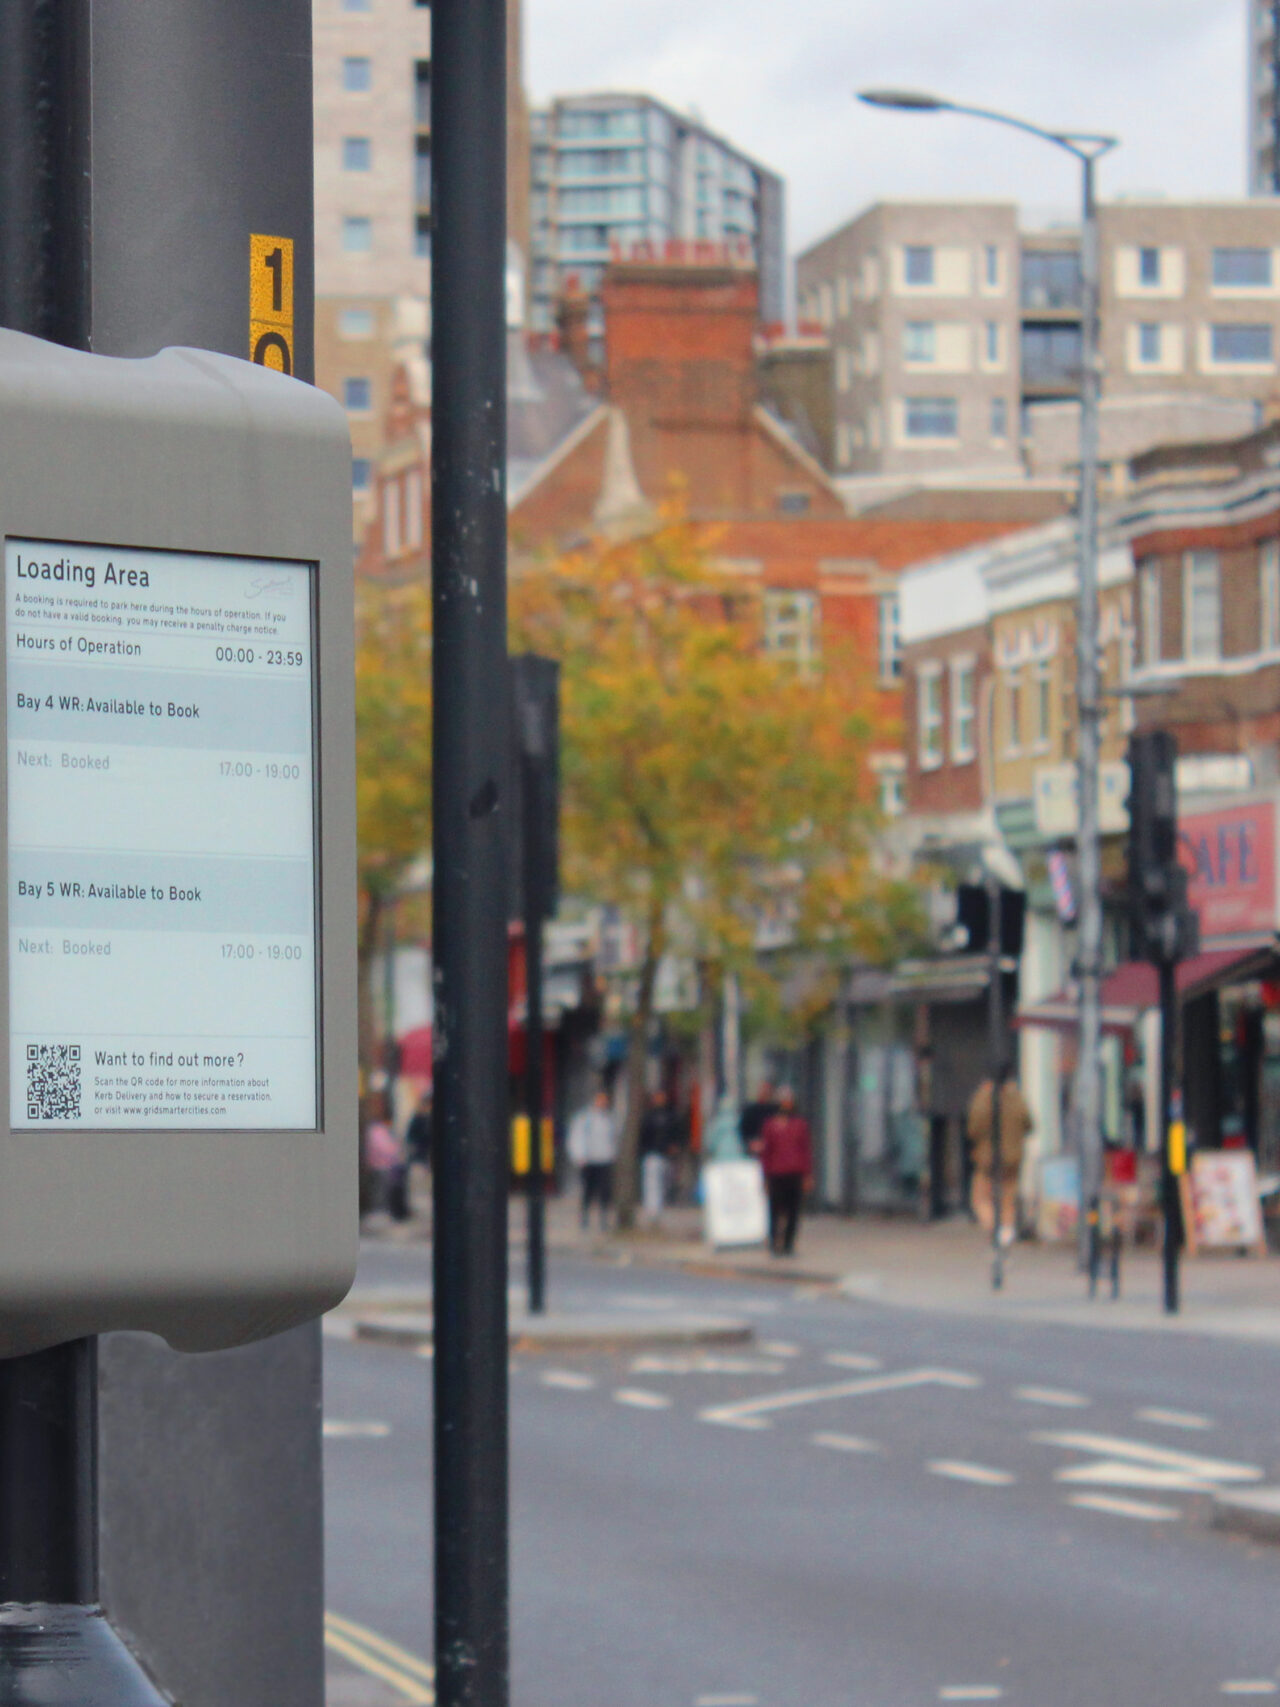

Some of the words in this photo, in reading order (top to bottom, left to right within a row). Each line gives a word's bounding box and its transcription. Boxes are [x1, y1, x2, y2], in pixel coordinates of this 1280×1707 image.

[17, 555, 96, 588] Loading
[104, 562, 150, 588] Area
[15, 593, 21, 602] A
[23, 594, 54, 606] booking
[56, 595, 64, 605] is
[65, 598, 98, 609] required
[100, 599, 109, 609] to
[111, 601, 128, 612] park
[130, 602, 148, 612] here
[149, 604, 174, 616] during
[176, 606, 189, 615] the
[190, 607, 212, 617] hours
[214, 608, 222, 617] of
[264, 611, 271, 620] If
[272, 614, 287, 623] you
[15, 607, 26, 617] do
[27, 609, 41, 618] not
[43, 610, 61, 620] have
[70, 613, 89, 622] valid
[126, 617, 141, 627] you
[142, 618, 158, 628] may
[160, 618, 188, 629] receive
[196, 621, 225, 632] penalty
[226, 622, 252, 635] charge
[16, 633, 55, 650] Hours
[60, 636, 73, 651] of
[77, 637, 142, 656] Operation
[216, 646, 255, 664] 00:00
[266, 650, 303, 666] 23:59
[17, 692, 41, 712] Bay
[45, 695, 54, 709] 4
[149, 702, 162, 716] to
[167, 702, 200, 719] Book
[17, 752, 52, 768] Next:
[61, 752, 110, 770] Booked
[219, 761, 253, 777] 17:00
[265, 764, 300, 780] 19:00
[18, 881, 42, 899] Bay
[47, 881, 55, 896] 5
[151, 885, 164, 900] to
[169, 886, 202, 901] Book
[18, 939, 53, 955] Next:
[62, 939, 111, 956] Booked
[221, 944, 255, 959] 17:00
[267, 945, 302, 960] 19:00
[95, 1051, 127, 1066] Want
[132, 1052, 145, 1066] to
[149, 1051, 173, 1066] find
[178, 1053, 199, 1067] out
[94, 1076, 114, 1086] Scan
[116, 1076, 129, 1086] the
[131, 1076, 143, 1086] QR
[145, 1077, 164, 1086] code
[166, 1076, 177, 1086] for
[180, 1079, 199, 1087] more
[201, 1077, 245, 1087] information
[247, 1078, 269, 1087] about
[94, 1091, 113, 1100] Kerb
[116, 1091, 147, 1102] Delivery
[149, 1091, 163, 1100] and
[166, 1091, 181, 1101] how
[183, 1091, 191, 1101] to
[194, 1093, 218, 1101] secure
[94, 1106, 102, 1114] or
[105, 1105, 121, 1114] visit
[123, 1105, 226, 1117] www.gridsmartercities.com
